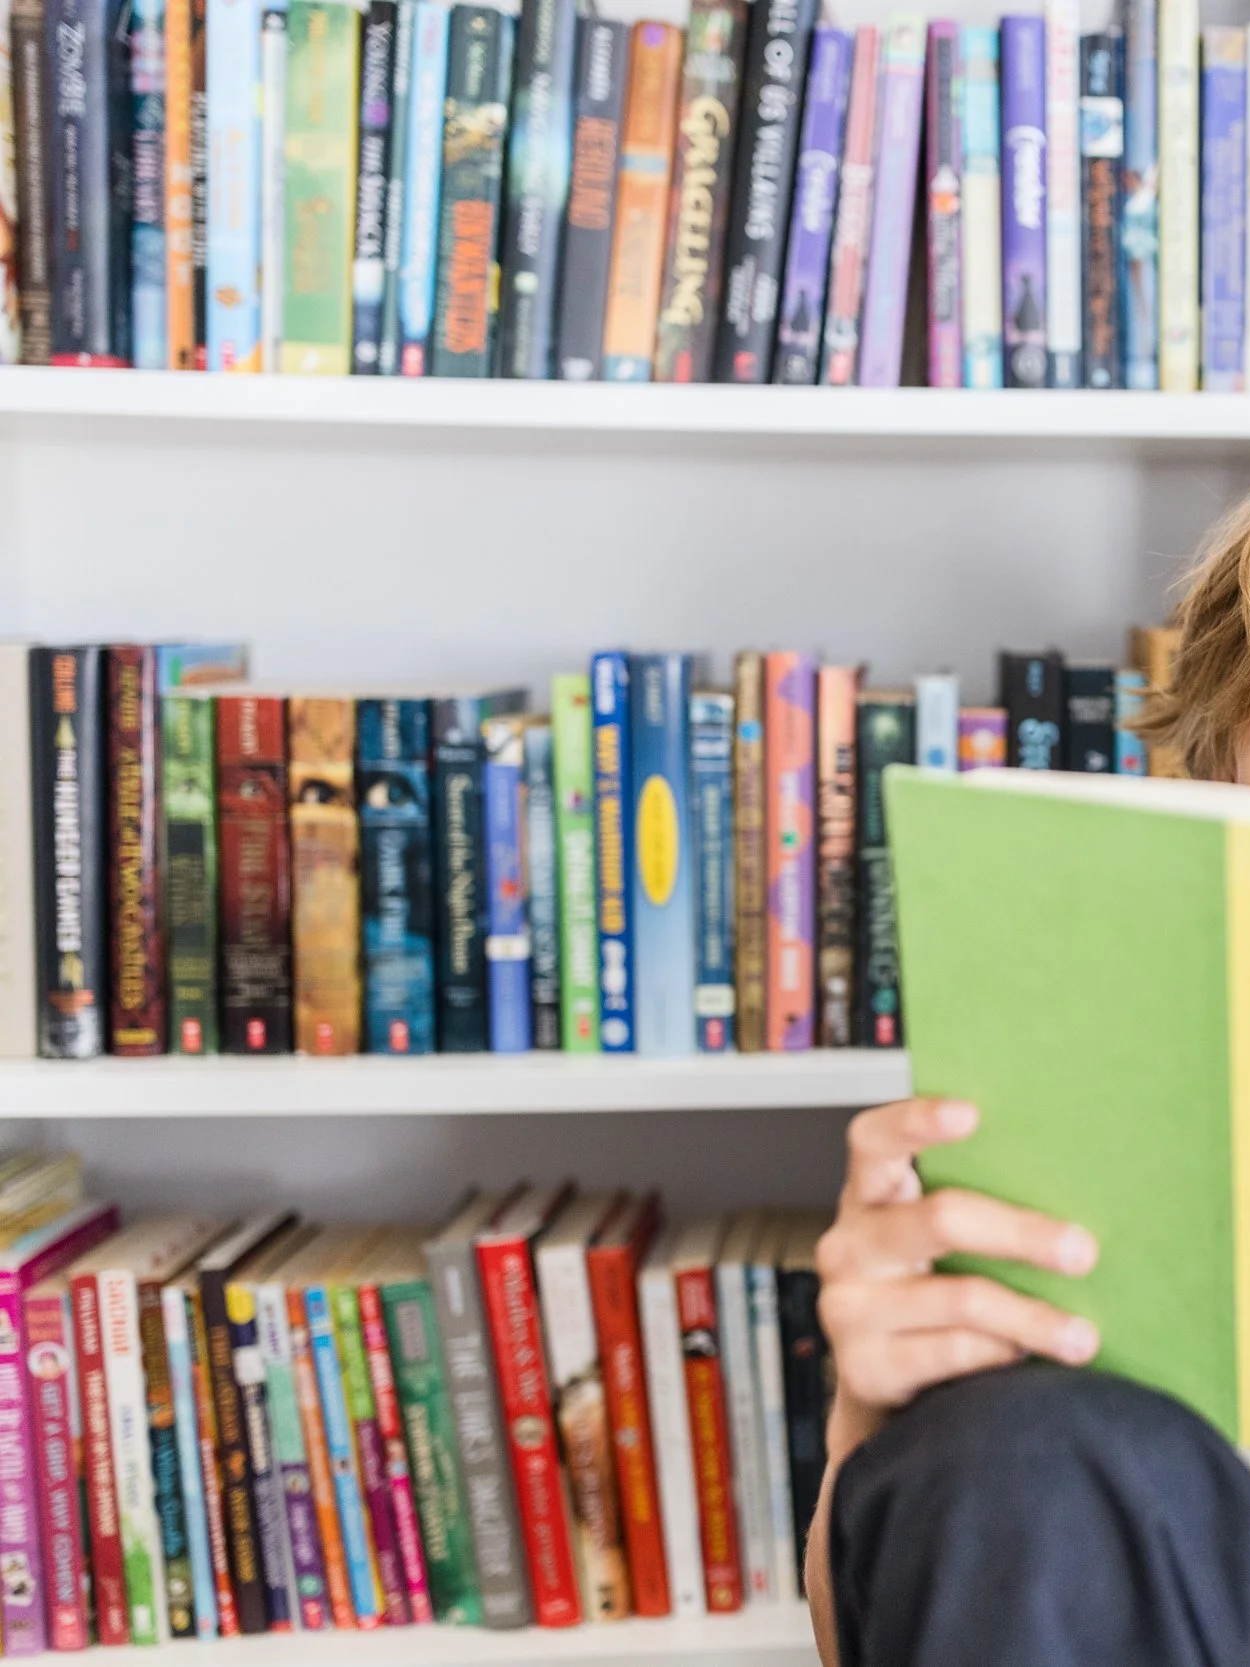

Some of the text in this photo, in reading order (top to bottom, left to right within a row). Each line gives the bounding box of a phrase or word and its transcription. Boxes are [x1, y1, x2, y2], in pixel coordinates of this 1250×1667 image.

[662, 96, 731, 326] GRACELING
[743, 125, 786, 241] VILLAINS
[54, 749, 82, 953] THE HUNGER GAMES
[44, 1421, 65, 1436] A
